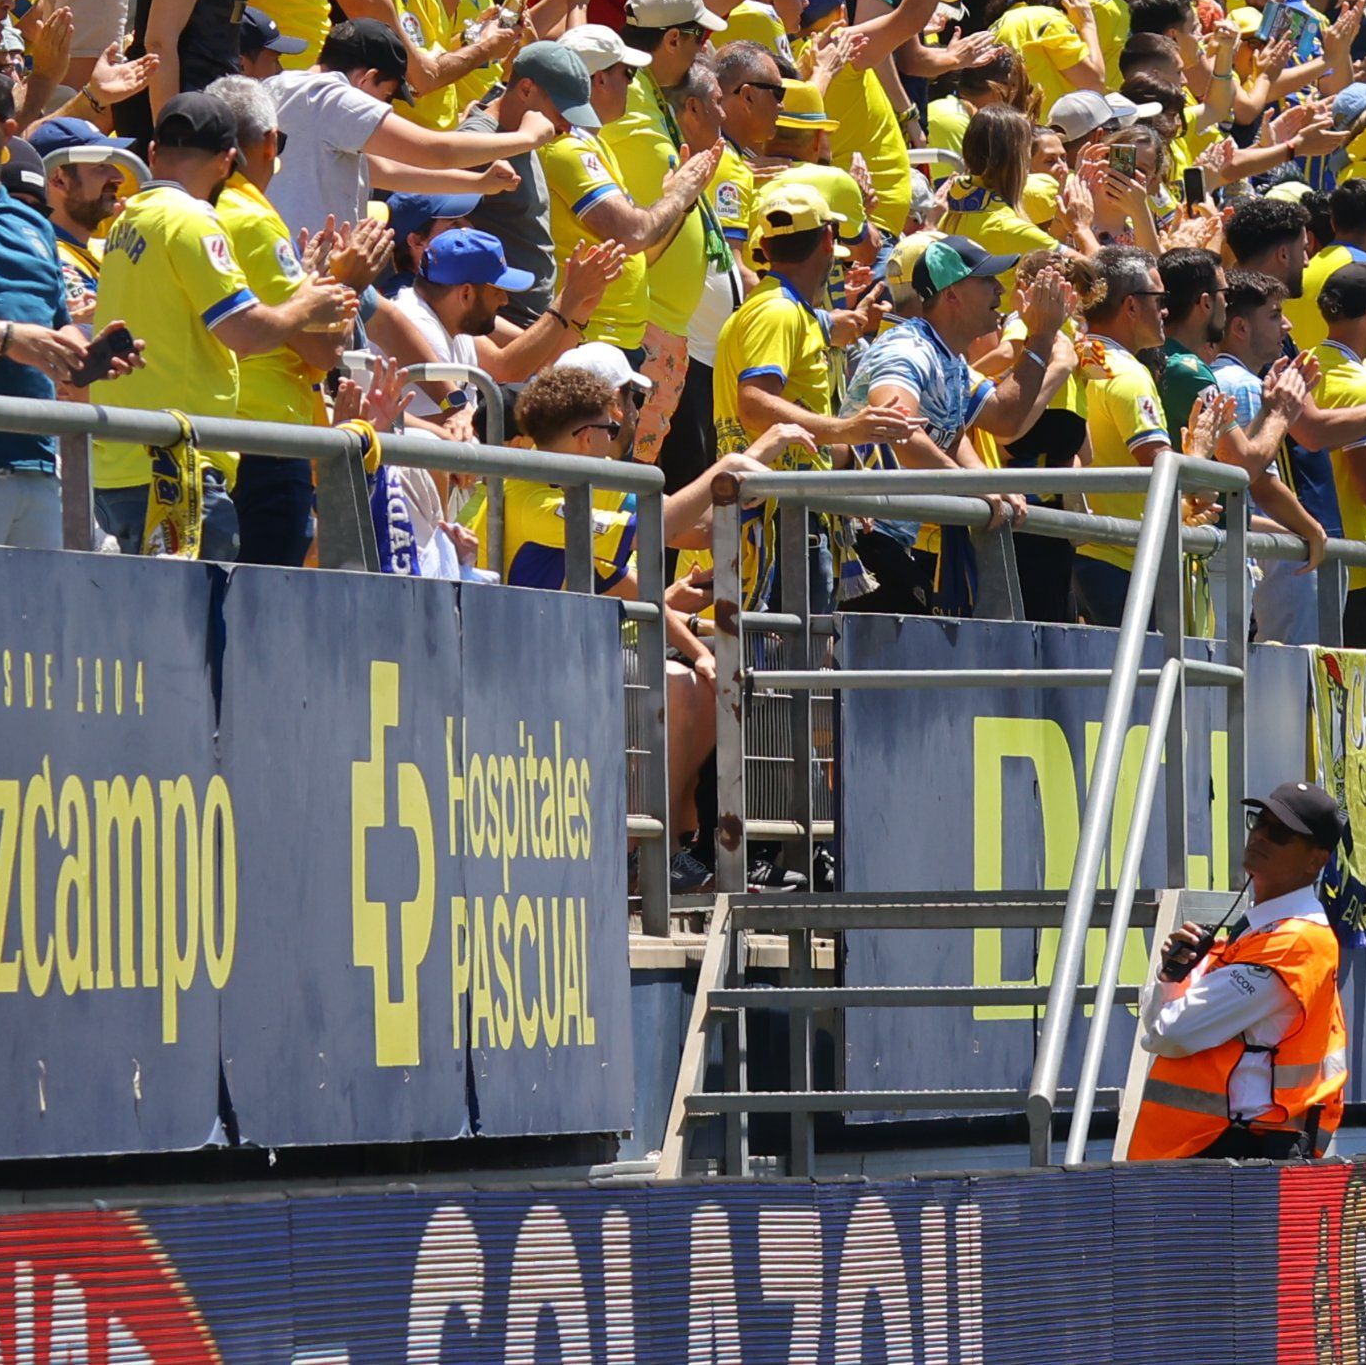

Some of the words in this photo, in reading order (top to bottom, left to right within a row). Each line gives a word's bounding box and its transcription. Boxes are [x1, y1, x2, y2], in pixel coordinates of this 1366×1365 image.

[74, 656, 147, 718] 1904
[446, 714, 592, 894] Hospitales
[449, 894, 596, 1051] PASCUAL
[1229, 969, 1256, 996] SICOR
